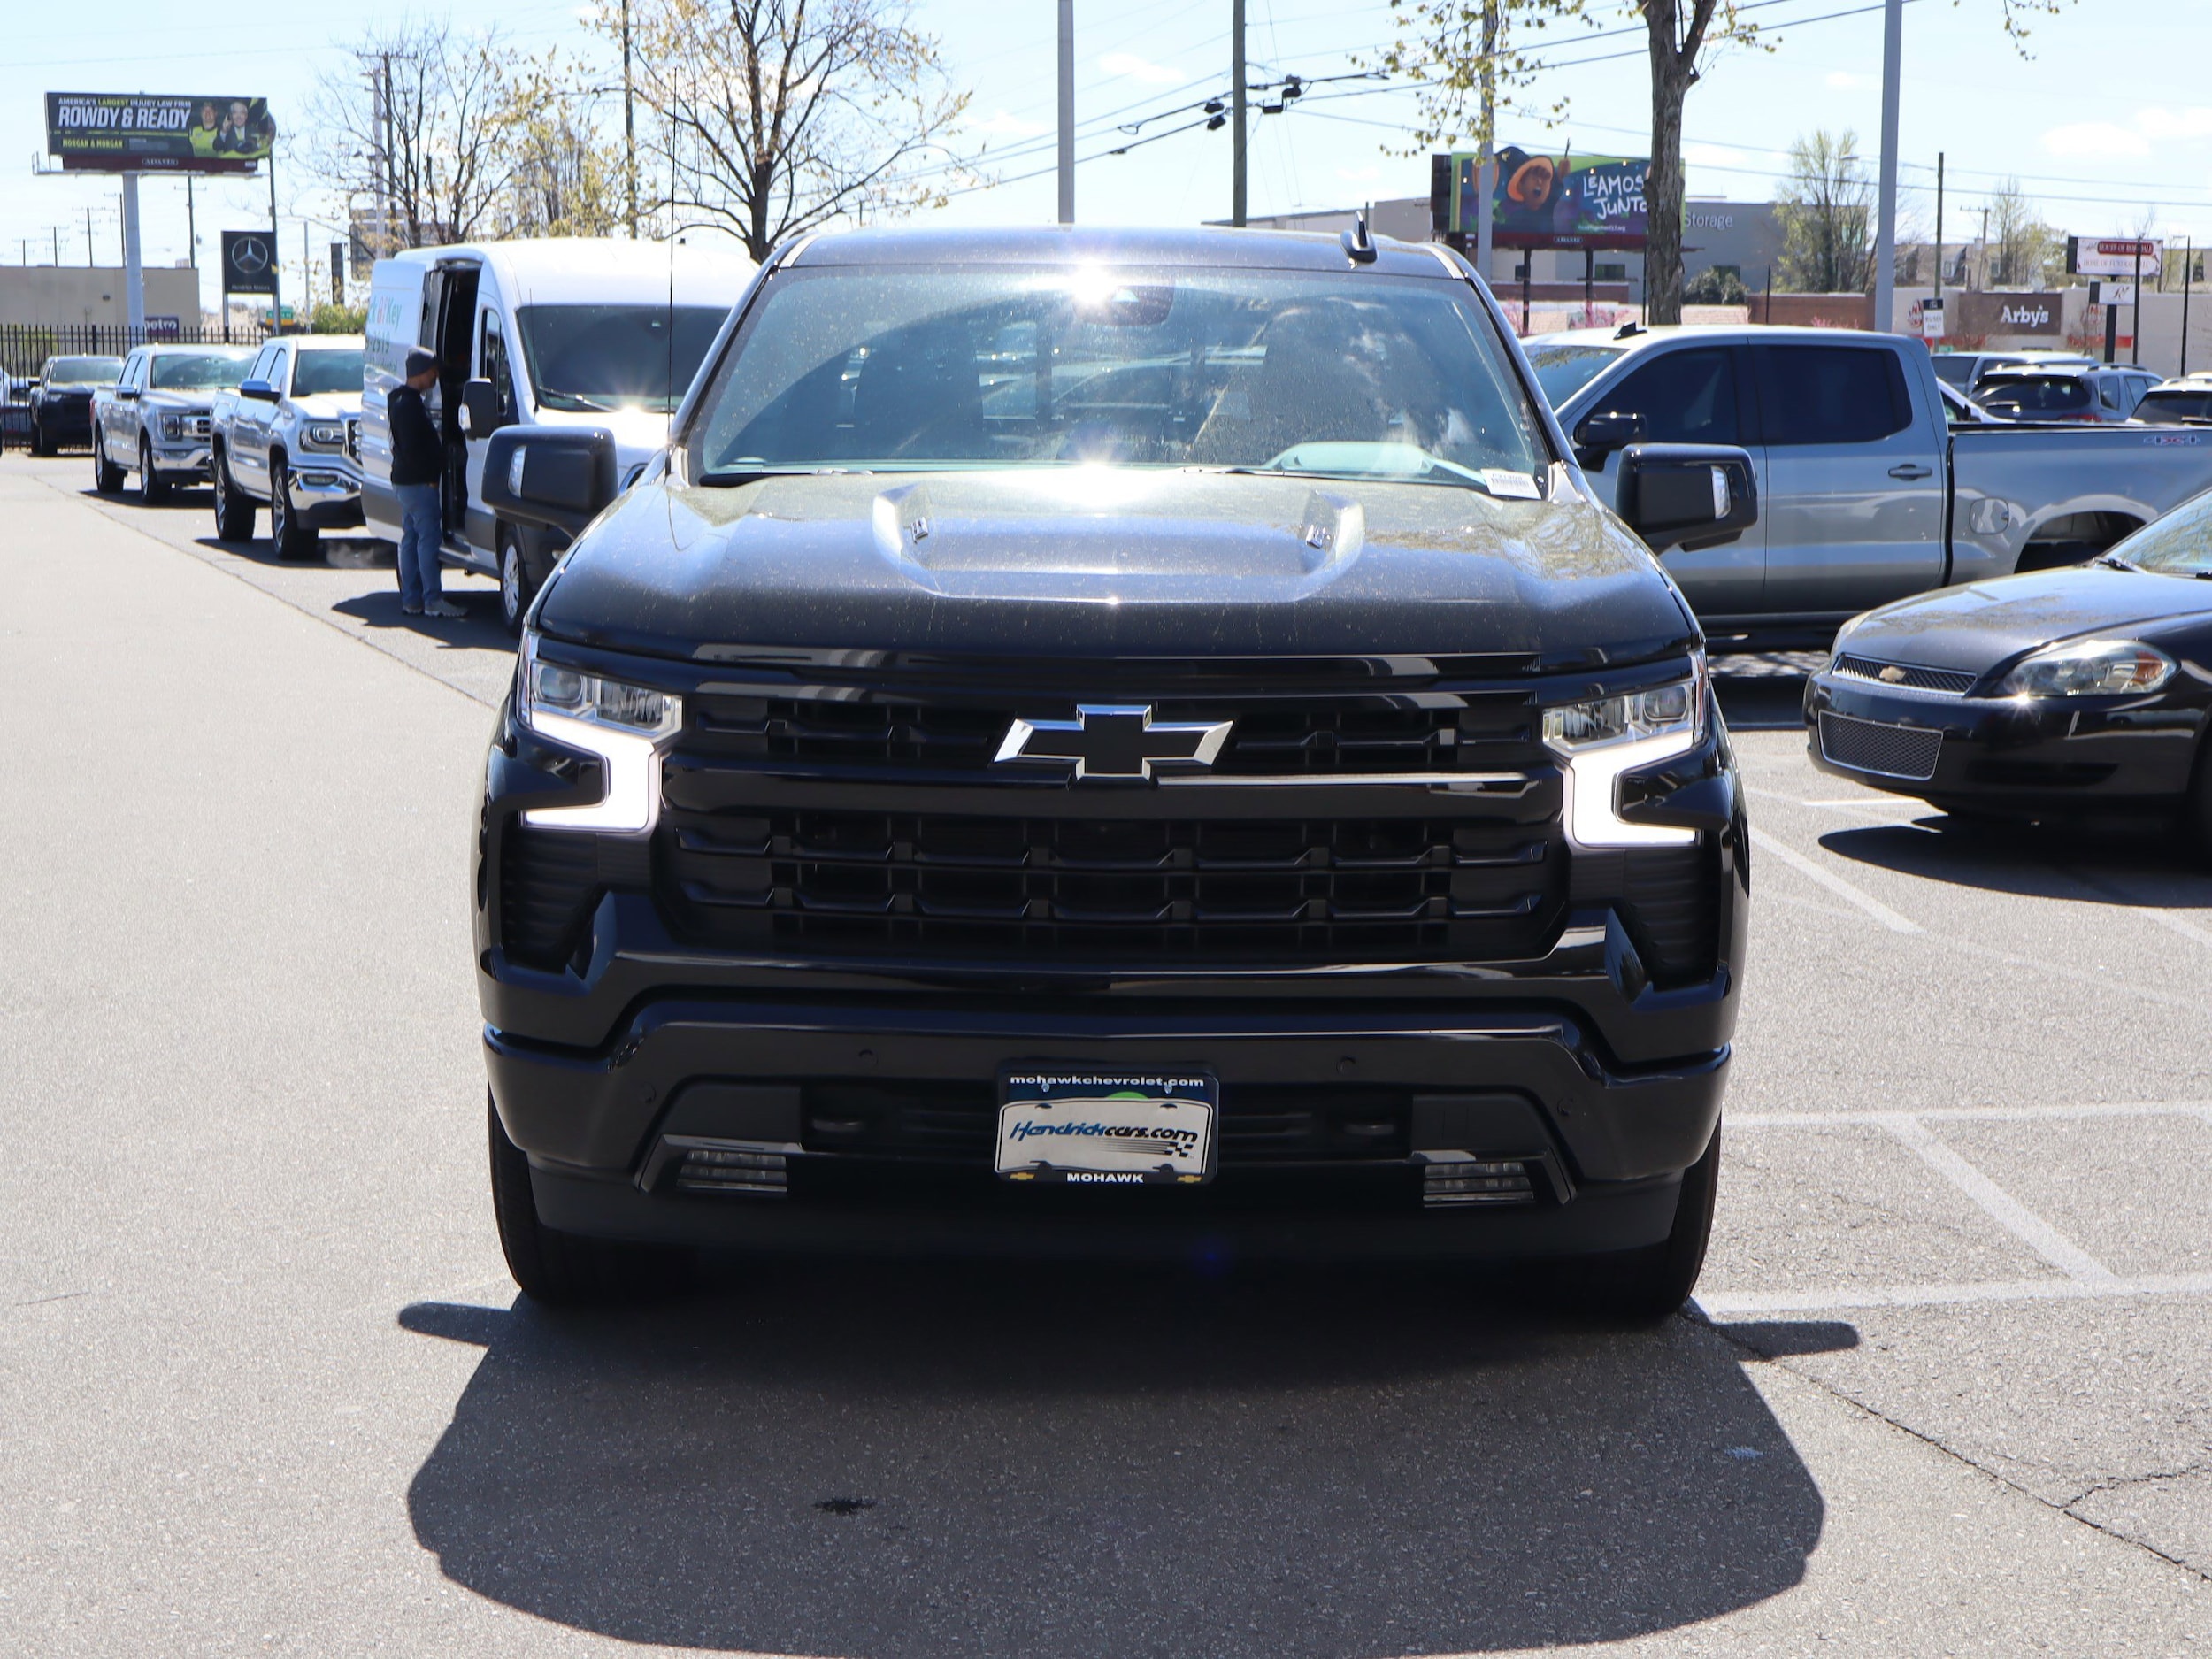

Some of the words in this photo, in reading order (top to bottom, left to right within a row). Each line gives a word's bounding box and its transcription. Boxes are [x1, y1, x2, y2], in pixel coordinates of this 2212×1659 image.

[58, 97, 96, 106] AMERICA'S
[130, 98, 156, 107] INJURY
[58, 106, 121, 127] ROWDY
[121, 107, 134, 128] &
[136, 108, 191, 130] READY
[62, 138, 89, 148] MORGAN
[96, 139, 123, 149] MORGAN
[1583, 174, 1644, 198] LEAMOS
[1593, 196, 1647, 220] JUNTO
[1685, 211, 1733, 230] Storage
[2001, 305, 2049, 328] Arby's
[1010, 1075, 1204, 1087] mohawkchevrolet.com
[1009, 1120, 1198, 1142] Hendrickcars.com
[1067, 1172, 1144, 1184] MOHAWK
